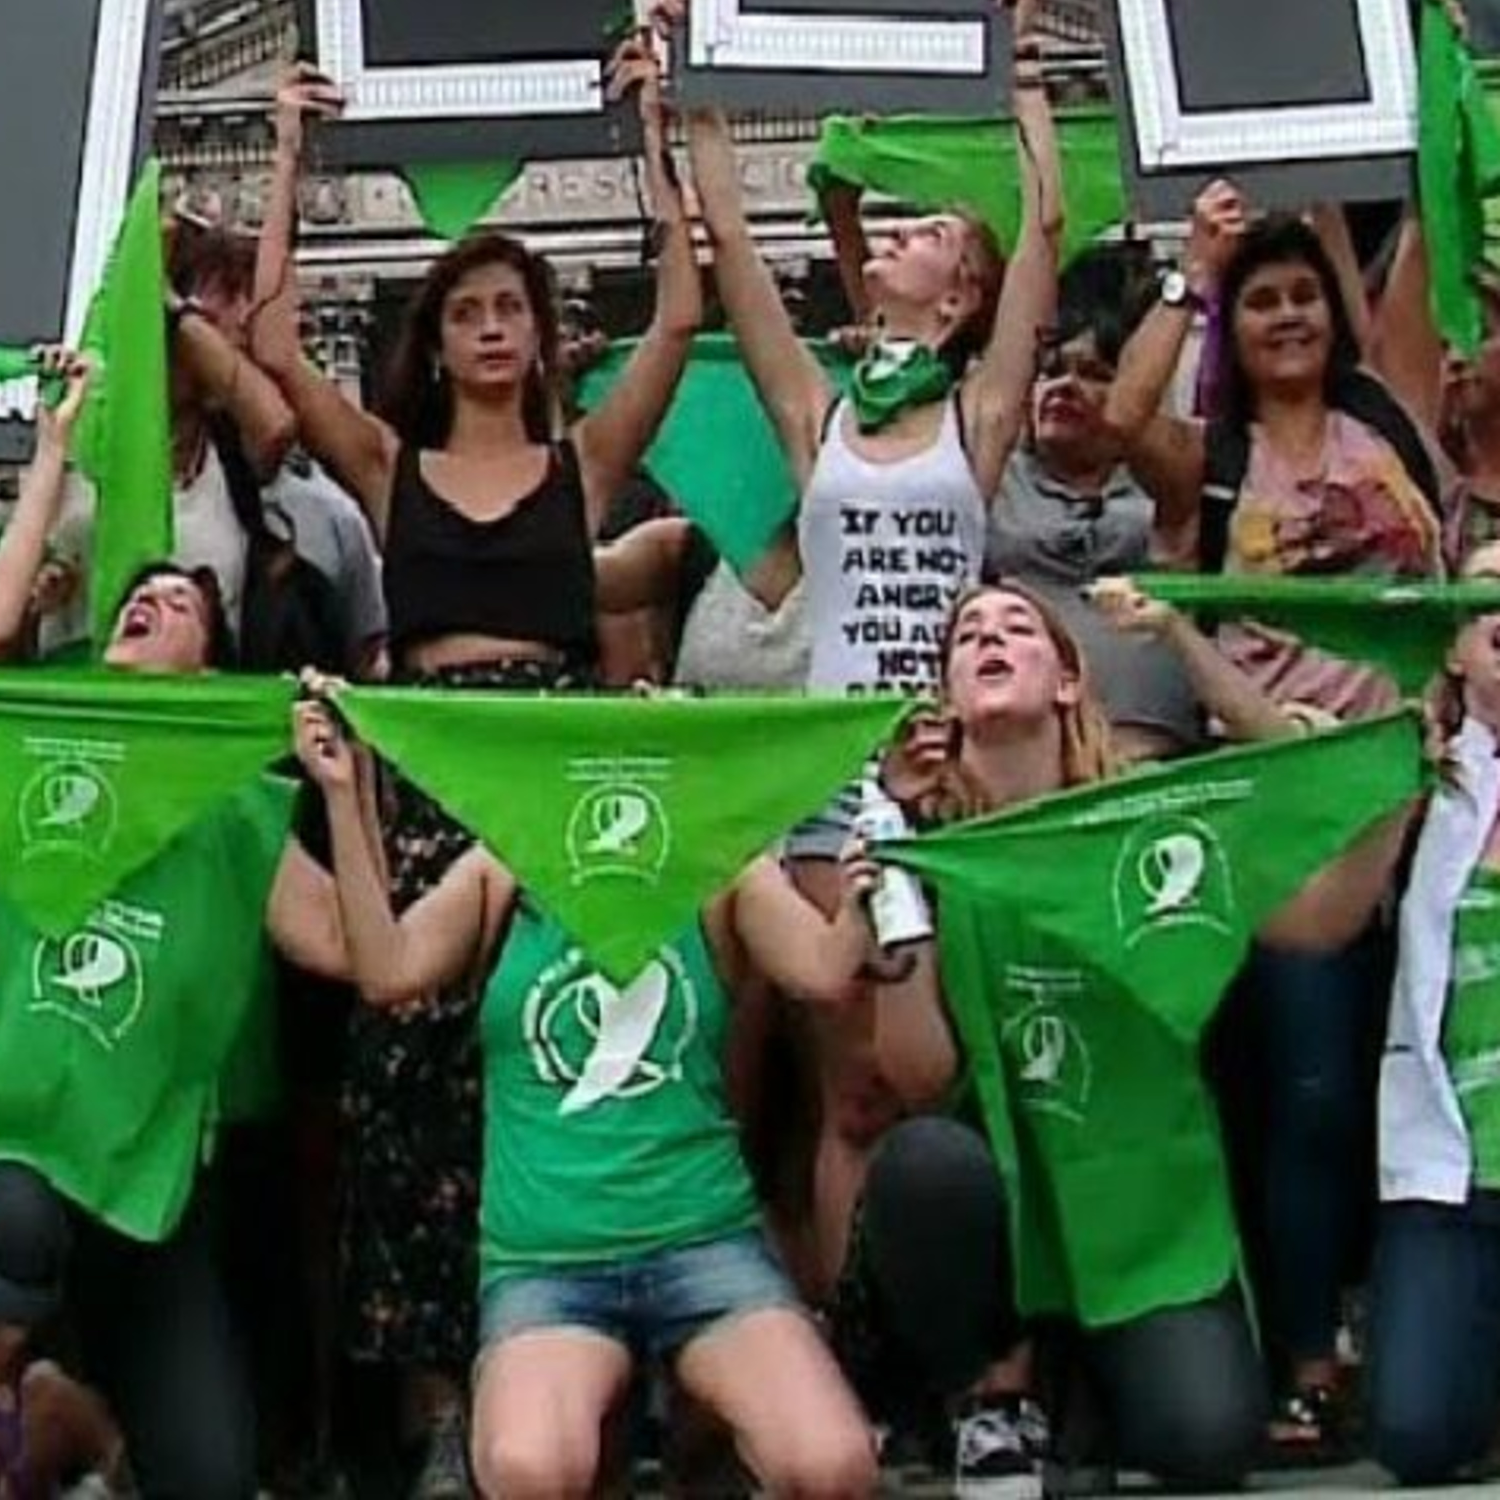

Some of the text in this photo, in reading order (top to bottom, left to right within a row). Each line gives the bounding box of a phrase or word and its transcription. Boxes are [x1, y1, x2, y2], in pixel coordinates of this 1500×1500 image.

[891, 510, 957, 537] YOU
[843, 548, 909, 574] ARE
[842, 620, 901, 644] YOU
